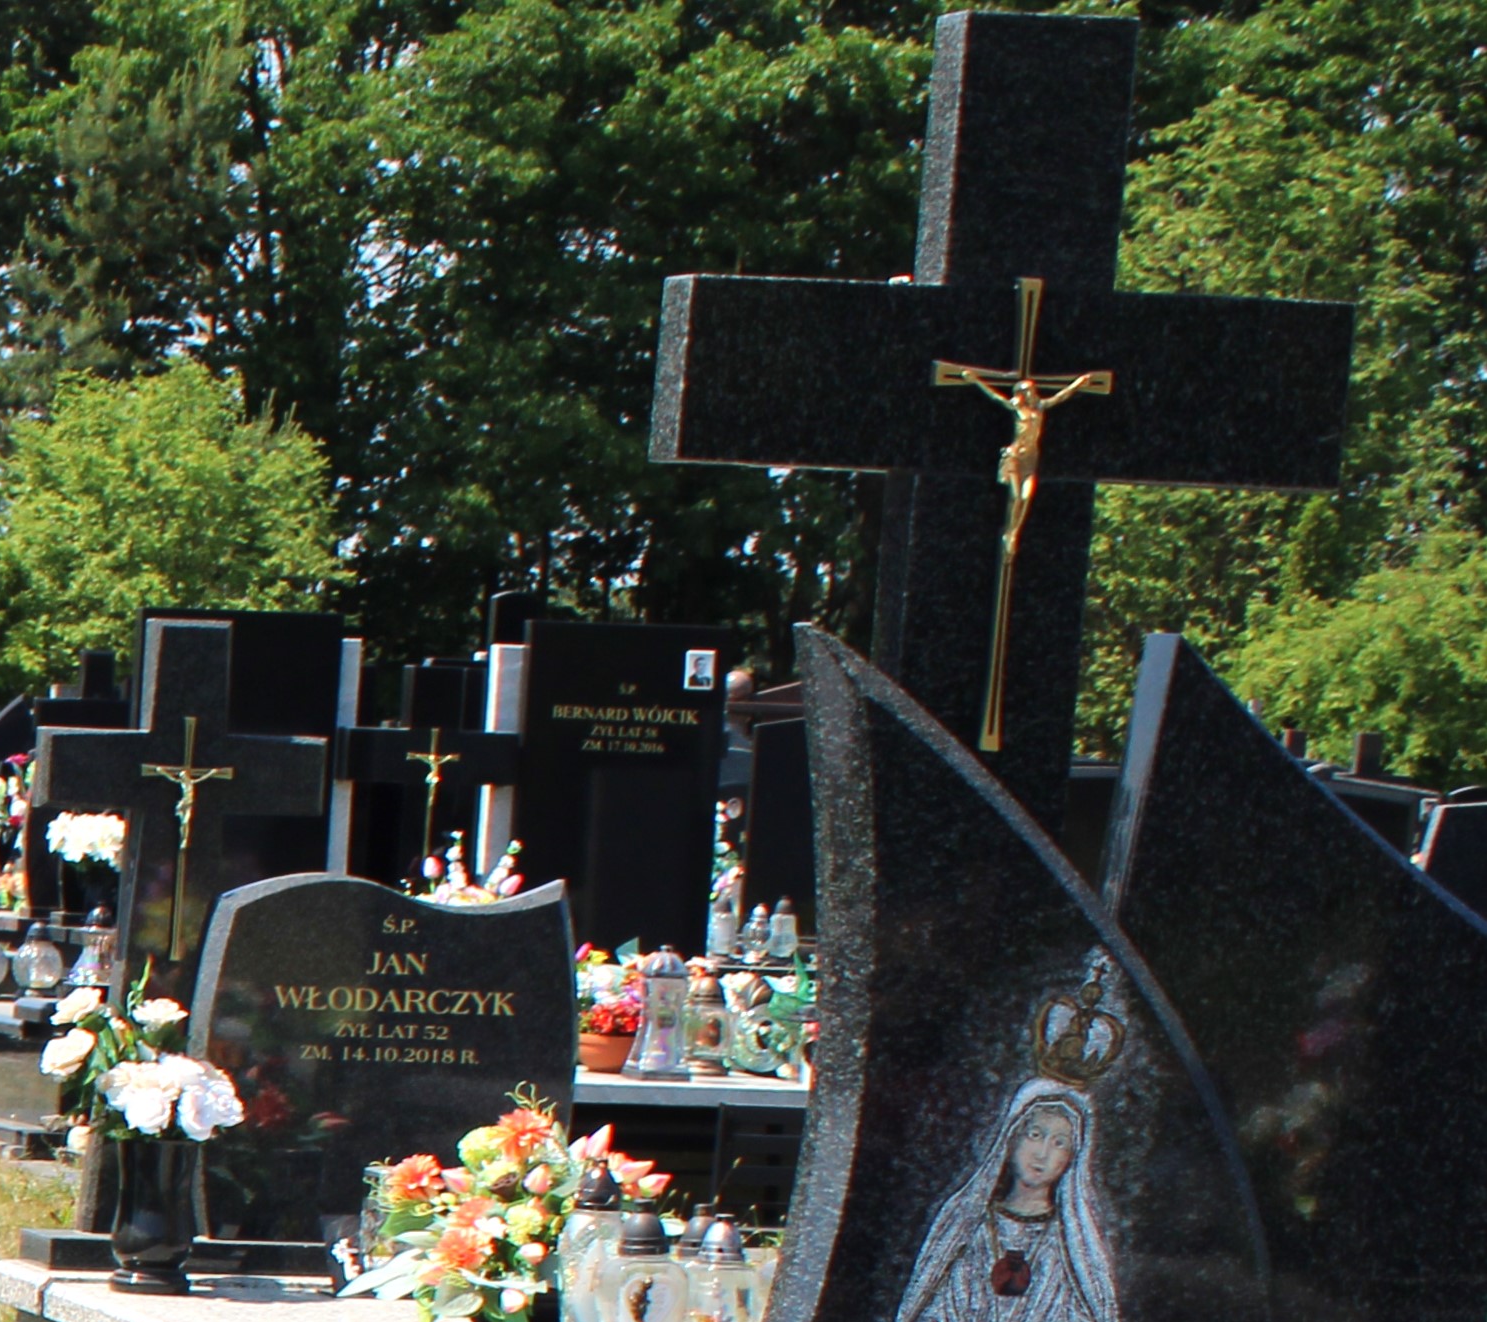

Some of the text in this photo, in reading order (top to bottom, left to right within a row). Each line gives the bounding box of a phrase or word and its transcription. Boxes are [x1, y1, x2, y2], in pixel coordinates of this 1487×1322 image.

[552, 704, 699, 725] BERNARD WÓJCIK
[365, 951, 429, 976] JAN
[274, 984, 516, 1017] WŁODARCZYK
[377, 1023, 418, 1040] LAT
[422, 1024, 450, 1041] 52
[299, 1044, 333, 1061] ZM.
[341, 1045, 455, 1064] 14.10.2018
